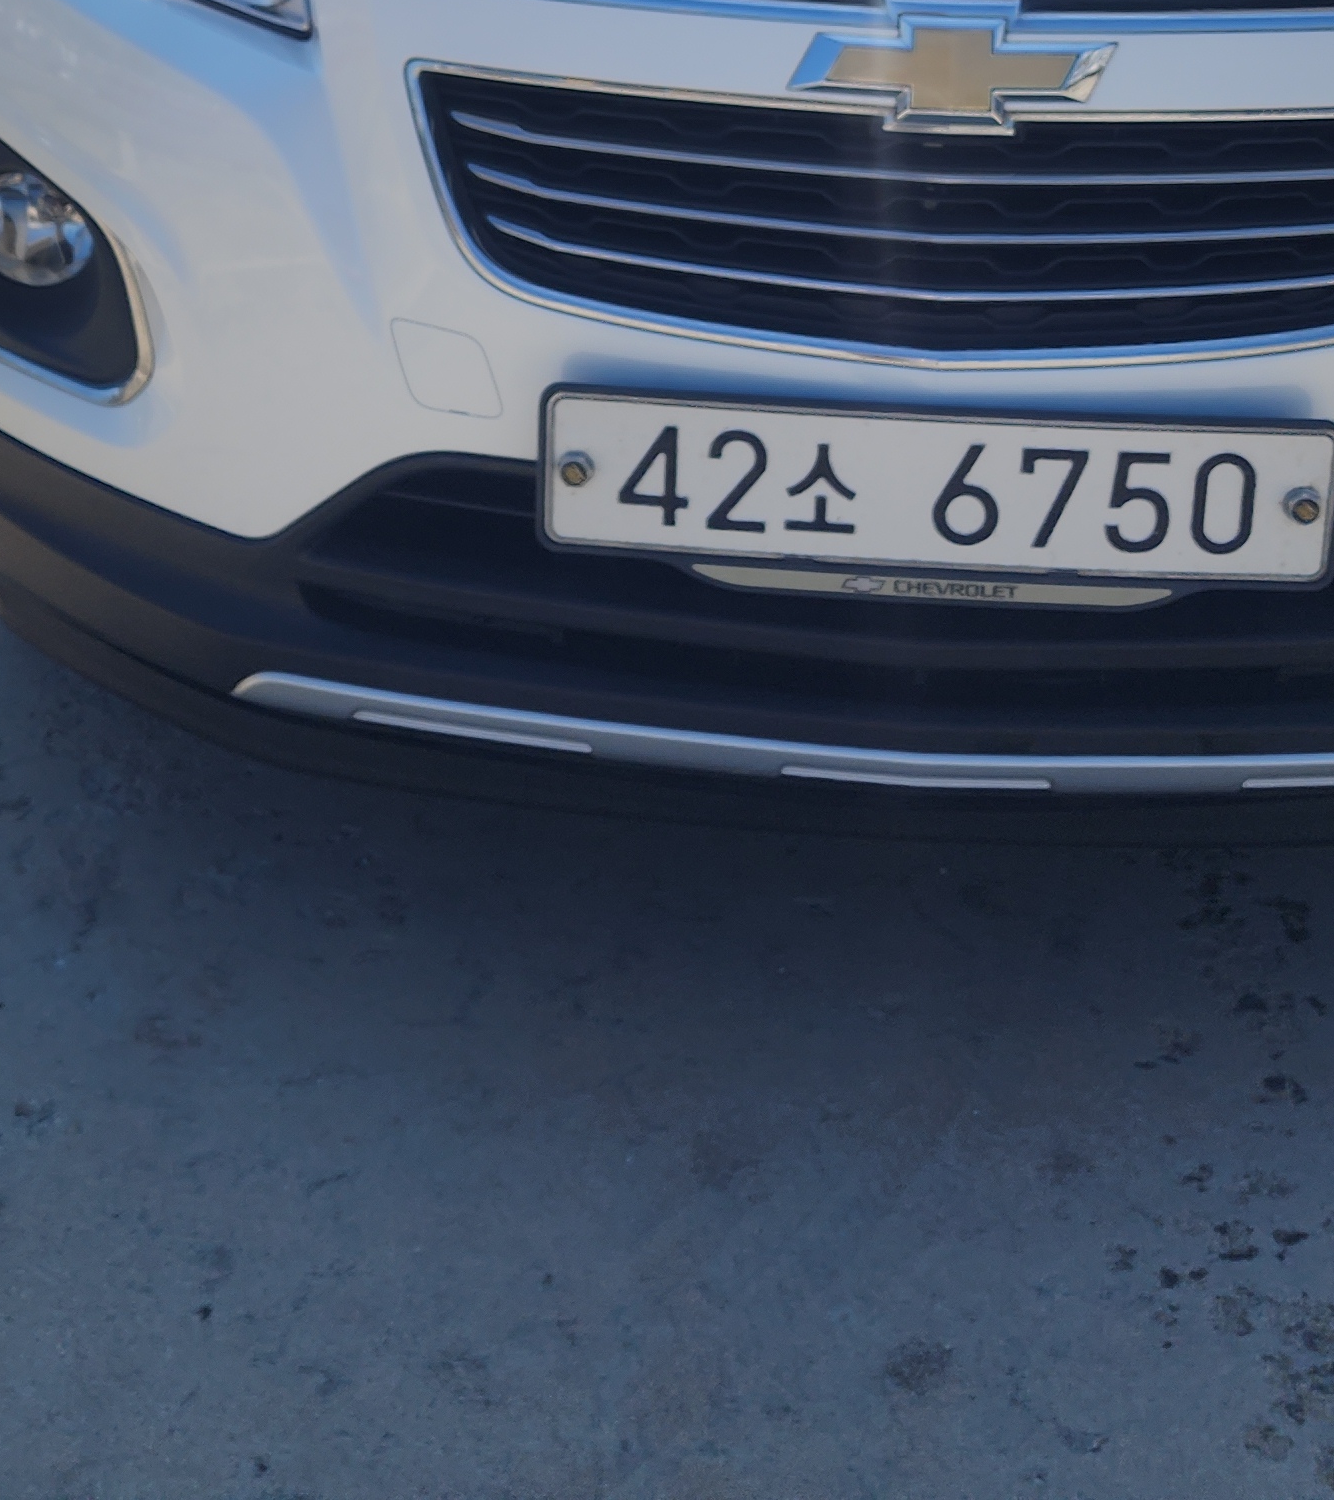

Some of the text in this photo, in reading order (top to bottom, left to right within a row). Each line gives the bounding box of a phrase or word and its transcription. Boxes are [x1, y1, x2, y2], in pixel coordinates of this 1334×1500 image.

[618, 425, 1257, 555] 42소 6750
[893, 578, 1017, 598] CHEVROLET
